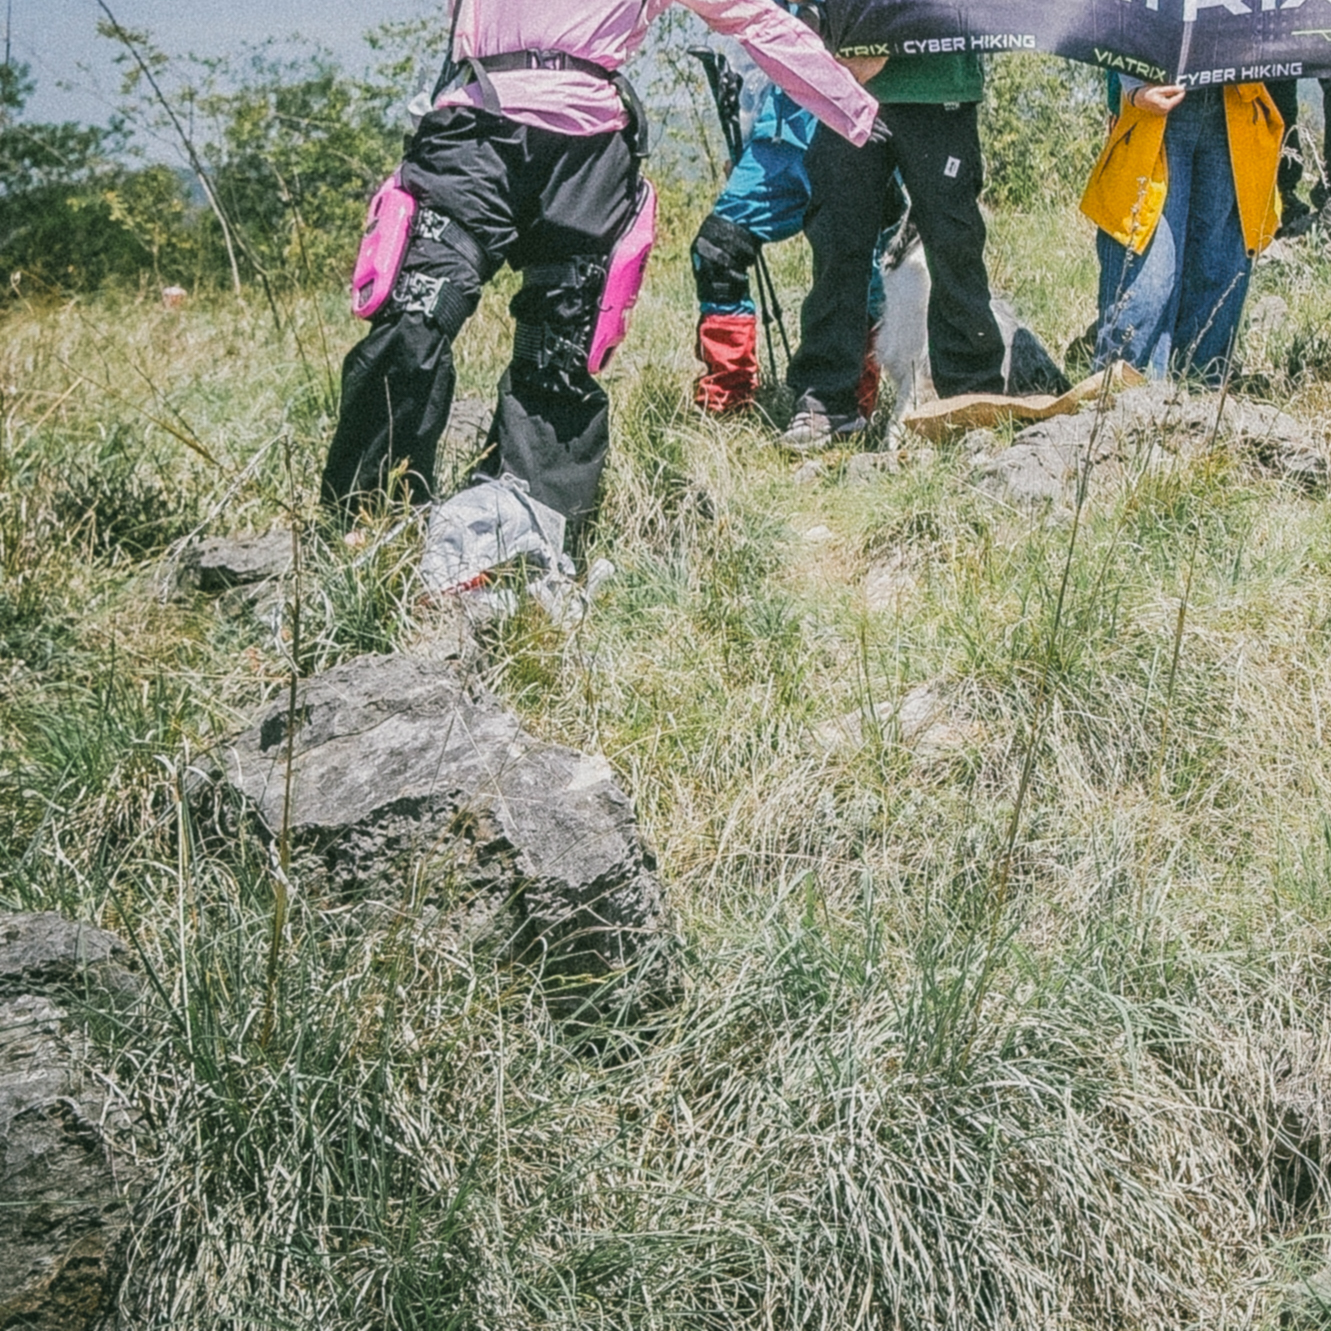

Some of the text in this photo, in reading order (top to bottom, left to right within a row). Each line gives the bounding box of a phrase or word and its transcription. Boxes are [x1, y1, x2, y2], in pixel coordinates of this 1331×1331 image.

[836, 34, 1036, 58] TRIX CYBER HIKING
[1094, 48, 1303, 88] VIATRIX CYBER HIKING
